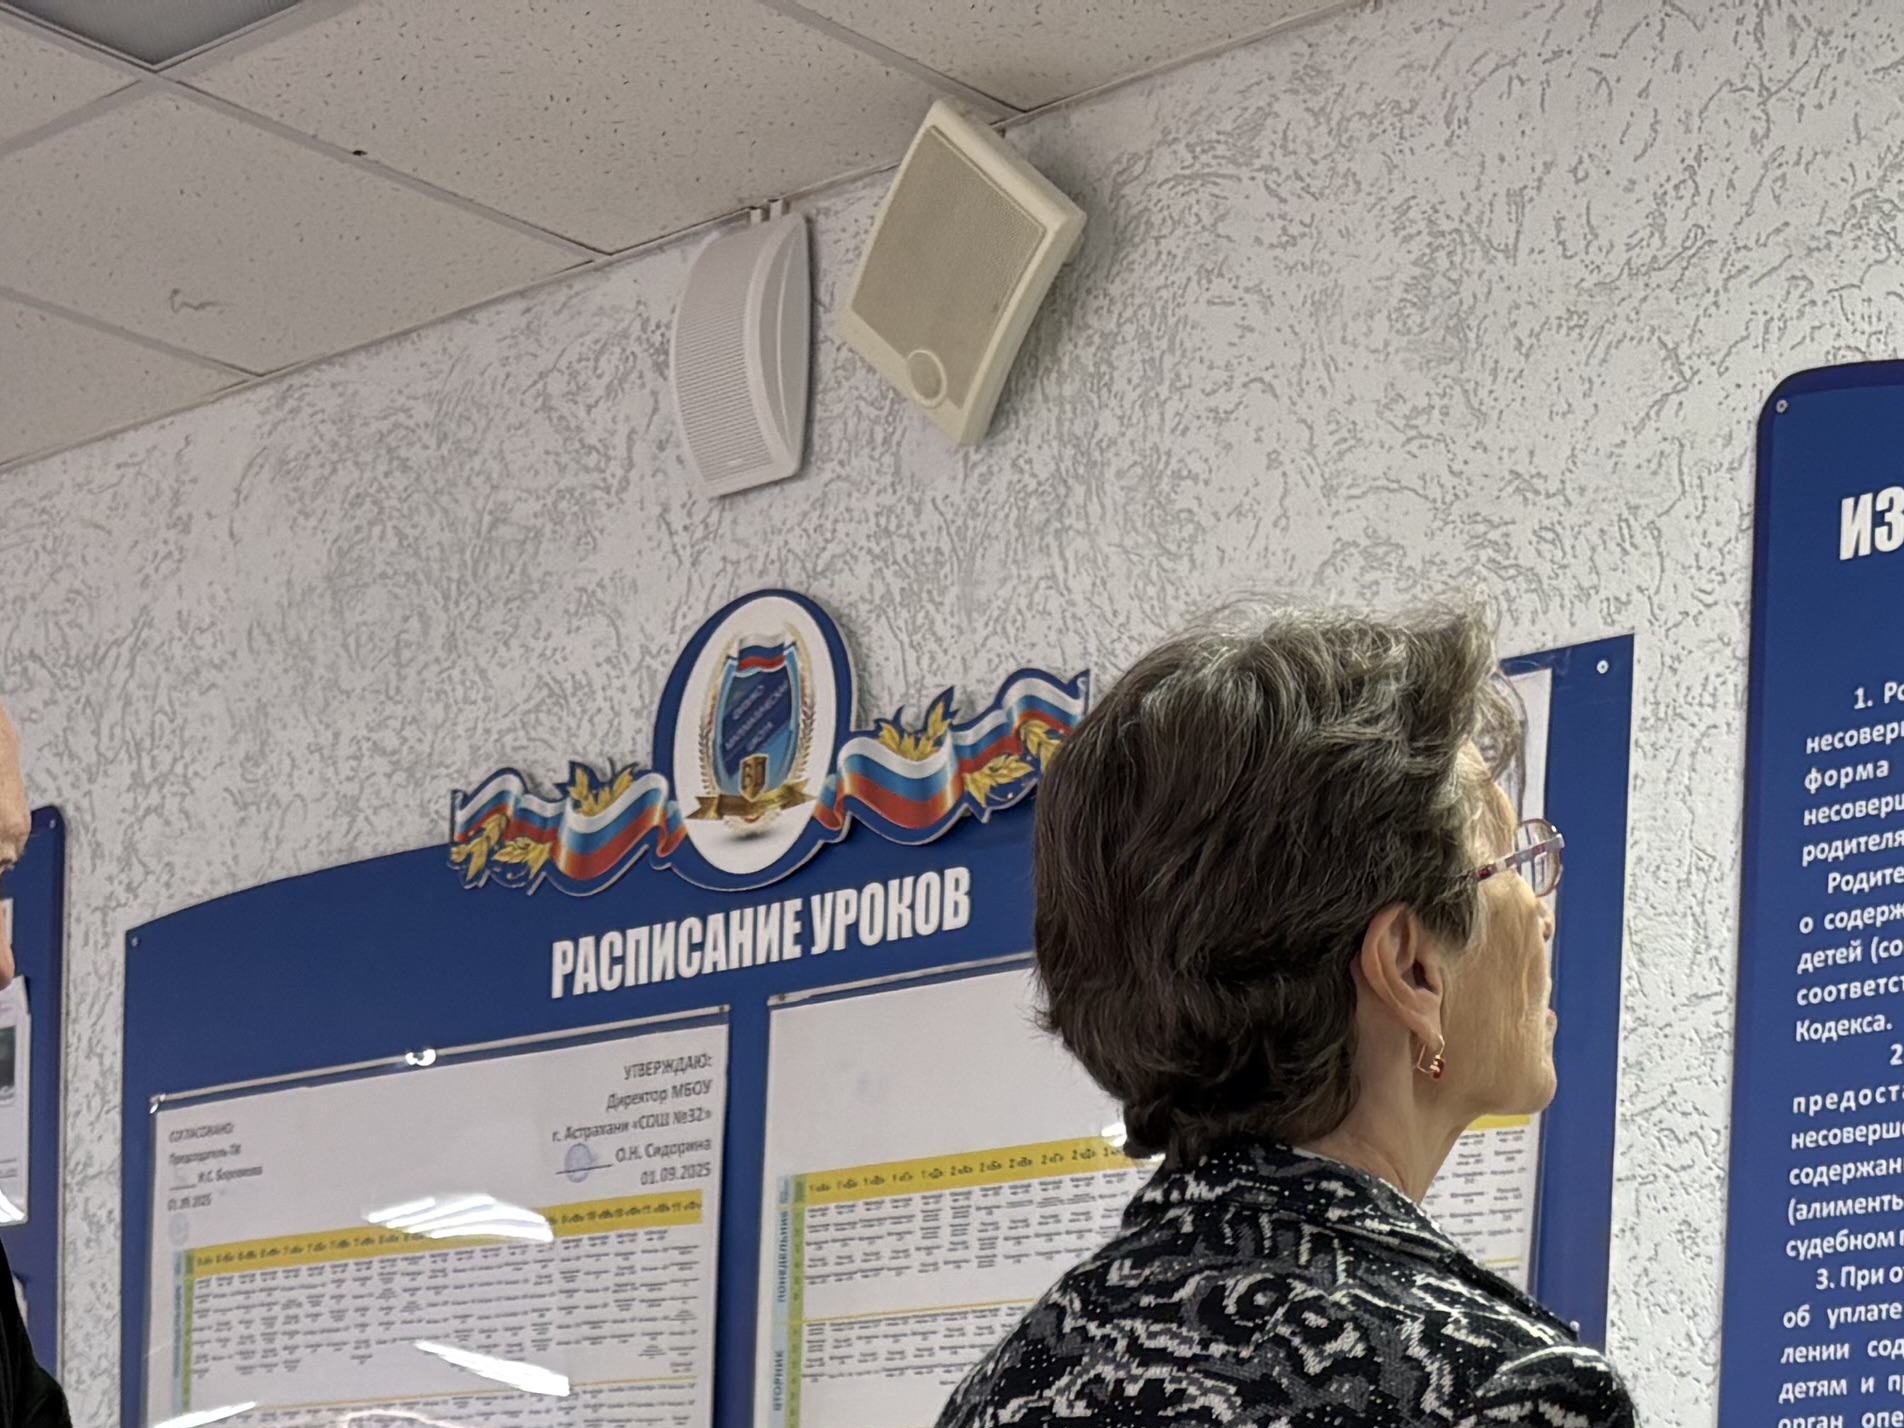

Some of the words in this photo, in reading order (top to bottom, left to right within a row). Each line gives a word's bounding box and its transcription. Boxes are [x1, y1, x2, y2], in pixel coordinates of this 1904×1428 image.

[1854, 687, 1873, 710] 1.
[1804, 760, 1889, 794] форма
[552, 899, 803, 998] РАСПИСАНИЕ
[811, 867, 969, 954] УРОКОВ
[1799, 916, 1814, 934] о
[1797, 939, 1862, 975] детей
[1796, 1014, 1892, 1043] Кодекса.
[624, 1053, 713, 1080] УТВЕРЖДАЮ:
[606, 1089, 668, 1113] Директор
[671, 1079, 713, 1098] МБОУ
[564, 1120, 630, 1142] Астрахани
[1786, 1229, 1895, 1261] судебном
[1815, 1268, 1835, 1290] 3.
[1840, 1265, 1885, 1291] При
[1783, 1304, 1811, 1329] об
[1826, 1302, 1903, 1330] уплате
[1780, 1343, 1850, 1364] лении
[772, 1350, 784, 1412] ВТОРНИК
[1778, 1378, 1847, 1404] детям
[1860, 1376, 1875, 1394] и
